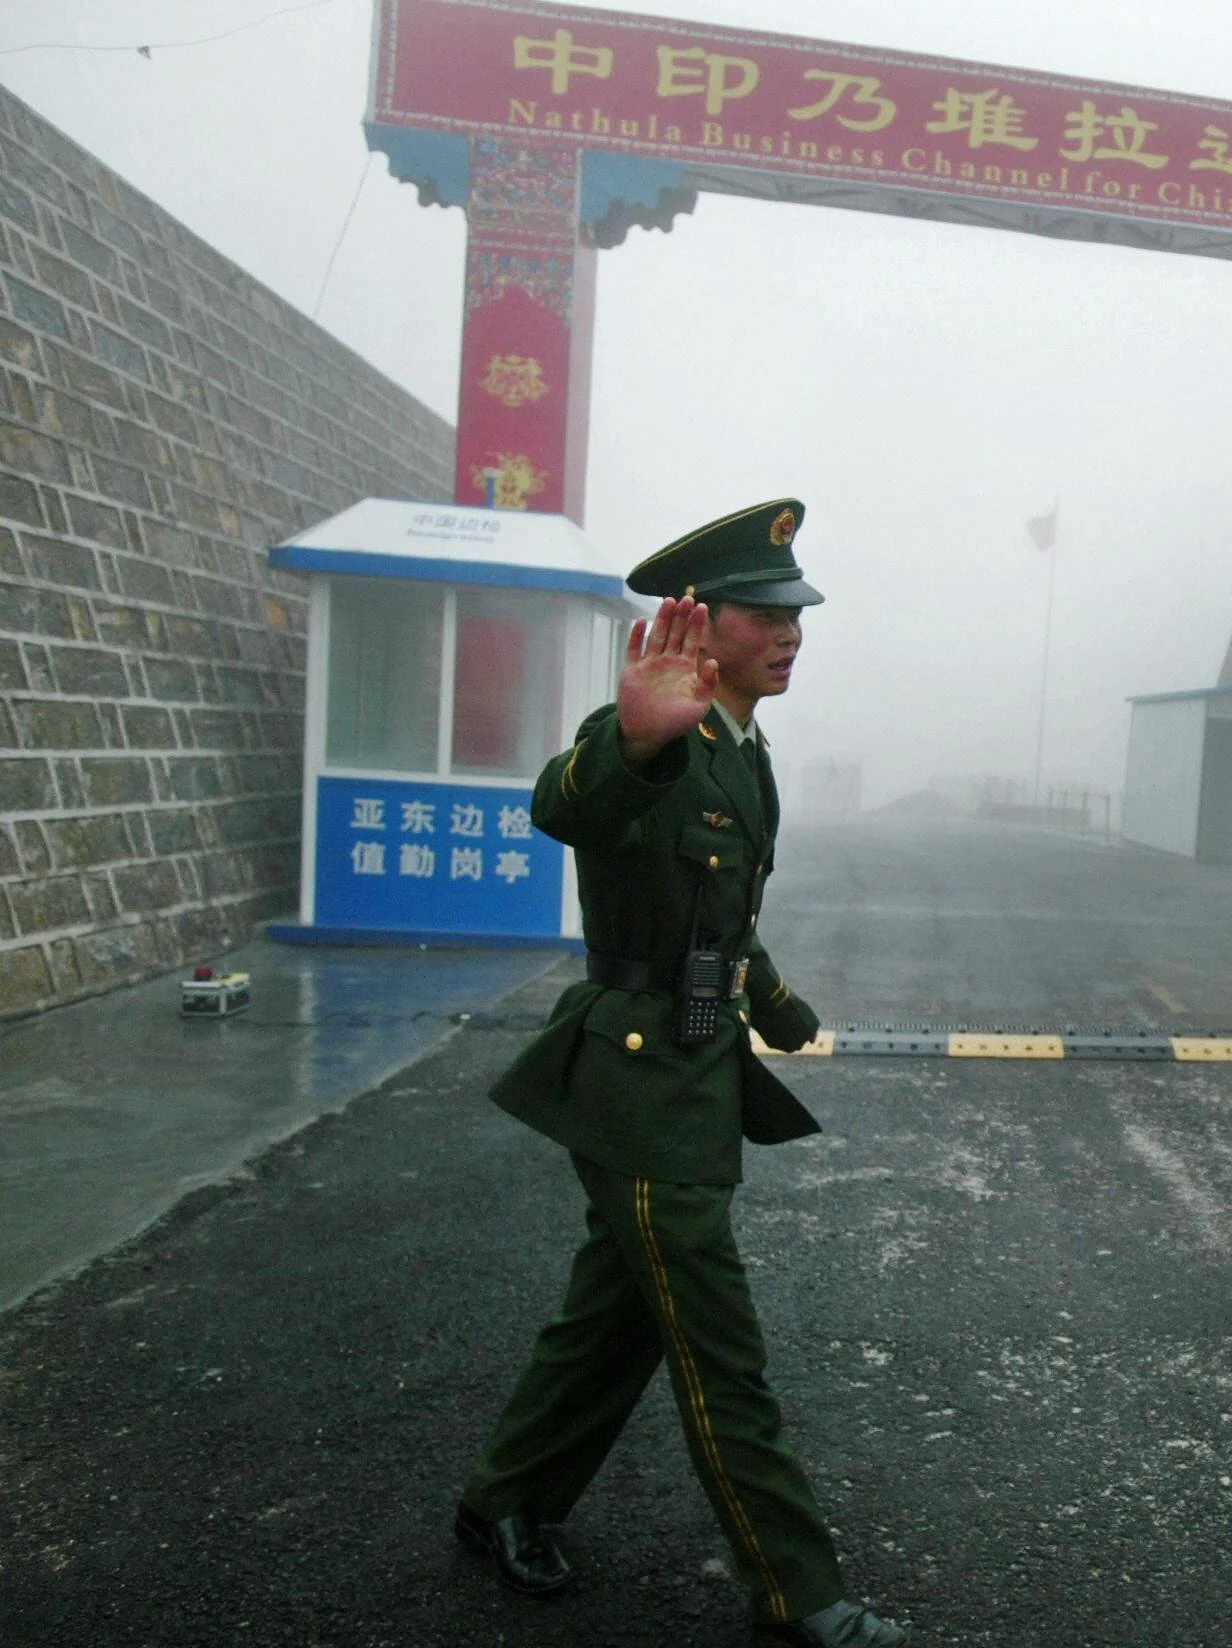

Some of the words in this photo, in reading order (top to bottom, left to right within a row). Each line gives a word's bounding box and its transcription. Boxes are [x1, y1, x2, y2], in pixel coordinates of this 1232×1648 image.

[510, 99, 683, 142] Nathula
[703, 122, 886, 166] Business
[902, 148, 1069, 189] Channel
[1084, 171, 1142, 200] for
[350, 798, 533, 838] 亚东边检
[350, 840, 531, 884] 值勤岗亭
